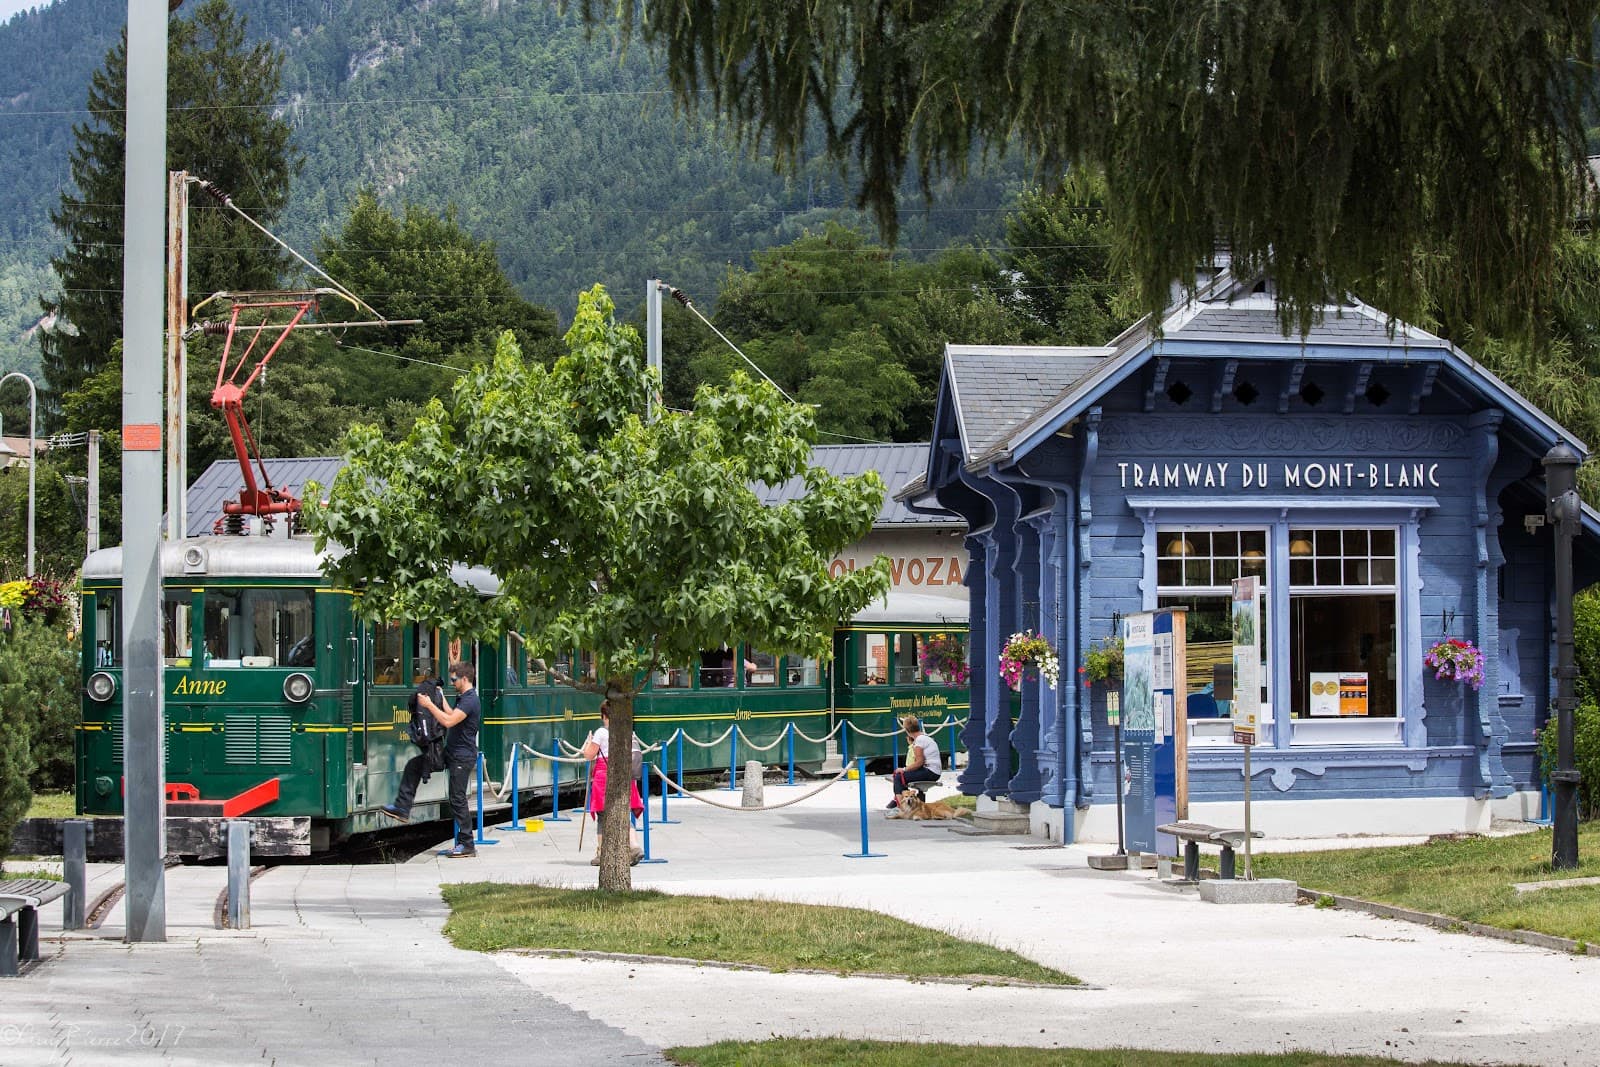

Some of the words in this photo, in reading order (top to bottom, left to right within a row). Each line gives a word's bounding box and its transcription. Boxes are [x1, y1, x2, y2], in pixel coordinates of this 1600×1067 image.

[1118, 462, 1229, 488] TRAMWAY
[1242, 463, 1268, 488] DU
[1285, 462, 1440, 488] MONT-BLANC
[889, 557, 963, 586] VOZA
[172, 675, 227, 695] Anne
[734, 707, 752, 721] Anne
